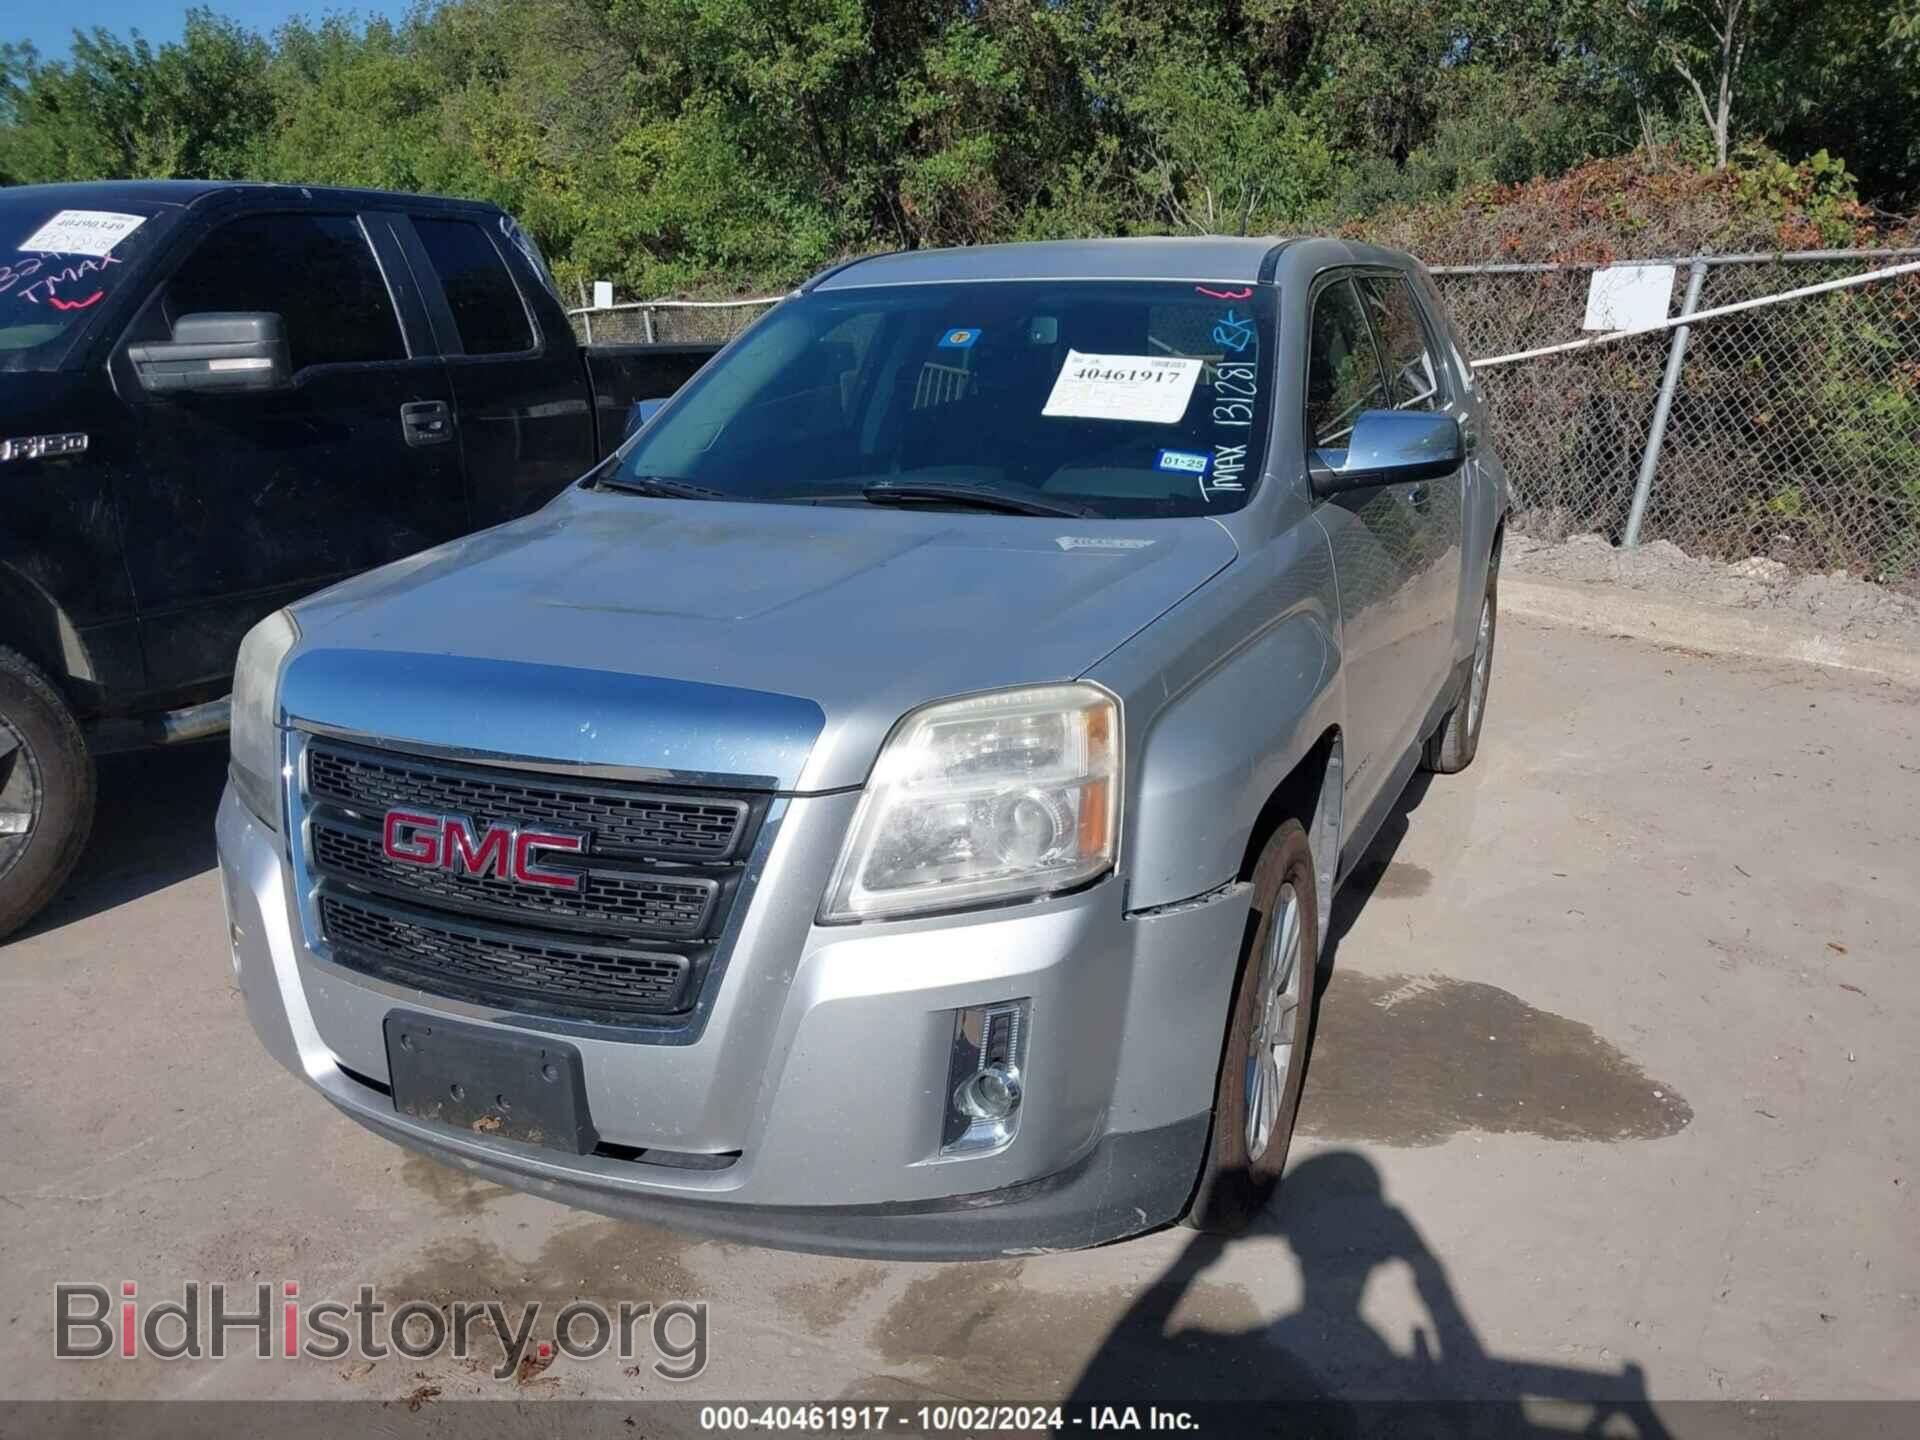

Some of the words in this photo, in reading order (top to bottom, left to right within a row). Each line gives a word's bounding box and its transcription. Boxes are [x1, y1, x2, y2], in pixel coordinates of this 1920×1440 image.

[18, 253, 122, 303] TMAX
[1073, 368, 1181, 384] 40461917
[1213, 362, 1257, 425] 131281
[1163, 456, 1205, 469] 01-25
[1198, 444, 1247, 502] TMAX
[384, 807, 589, 890] GMC
